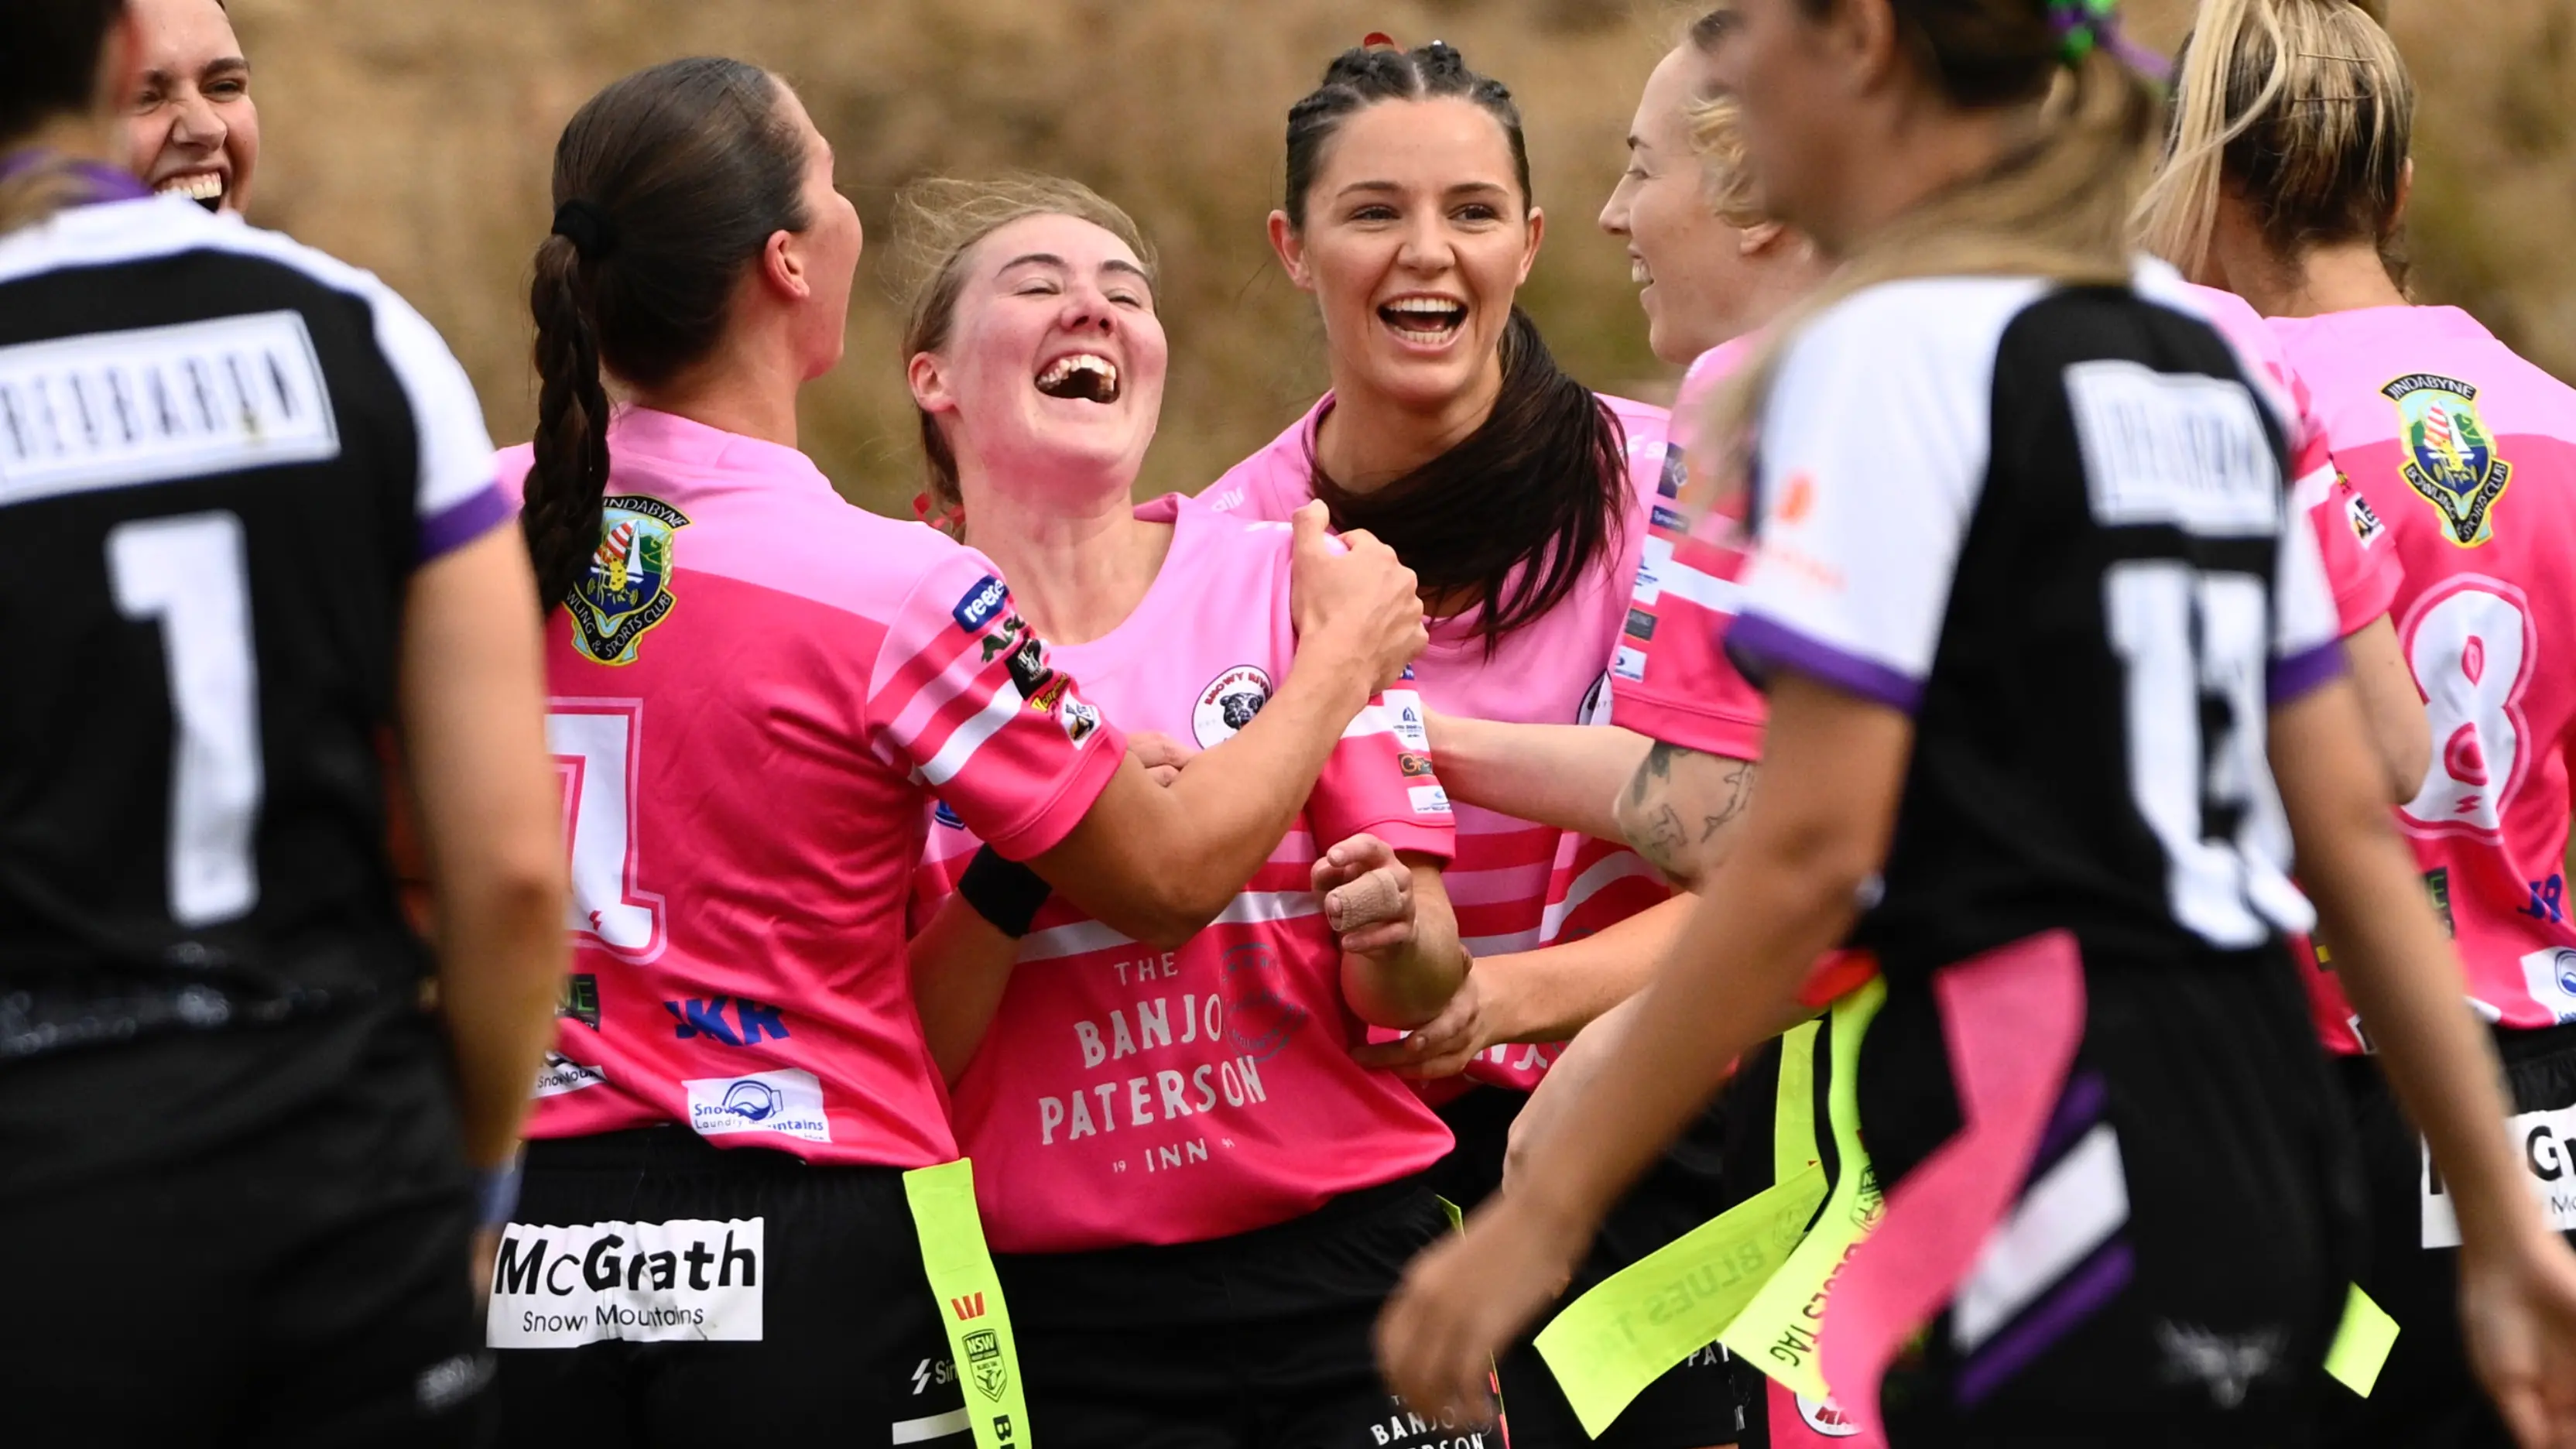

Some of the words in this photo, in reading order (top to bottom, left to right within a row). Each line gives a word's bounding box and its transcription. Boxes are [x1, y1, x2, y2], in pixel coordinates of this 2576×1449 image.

[2388, 375, 2473, 399] JINDABYNE
[604, 498, 687, 529] INDABYNE
[2405, 466, 2457, 519] BOWLING
[2484, 464, 2507, 496] CLUB
[566, 587, 596, 635] WLING
[591, 639, 601, 653] &
[605, 614, 643, 657] SPORTS
[643, 592, 671, 624] CLUB
[103, 509, 265, 926] 1
[2393, 577, 2533, 841] 8
[1115, 952, 1179, 986] THE
[1074, 993, 1222, 1069] BANJO
[1038, 1055, 1267, 1146] PATERSON
[766, 1119, 824, 1132] ntains
[1112, 1160, 1127, 1173] 19
[1145, 1137, 1208, 1173] INN
[495, 1229, 756, 1296] McGrath
[967, 1334, 995, 1354] NSW
[1769, 1324, 1819, 1368] TAG
